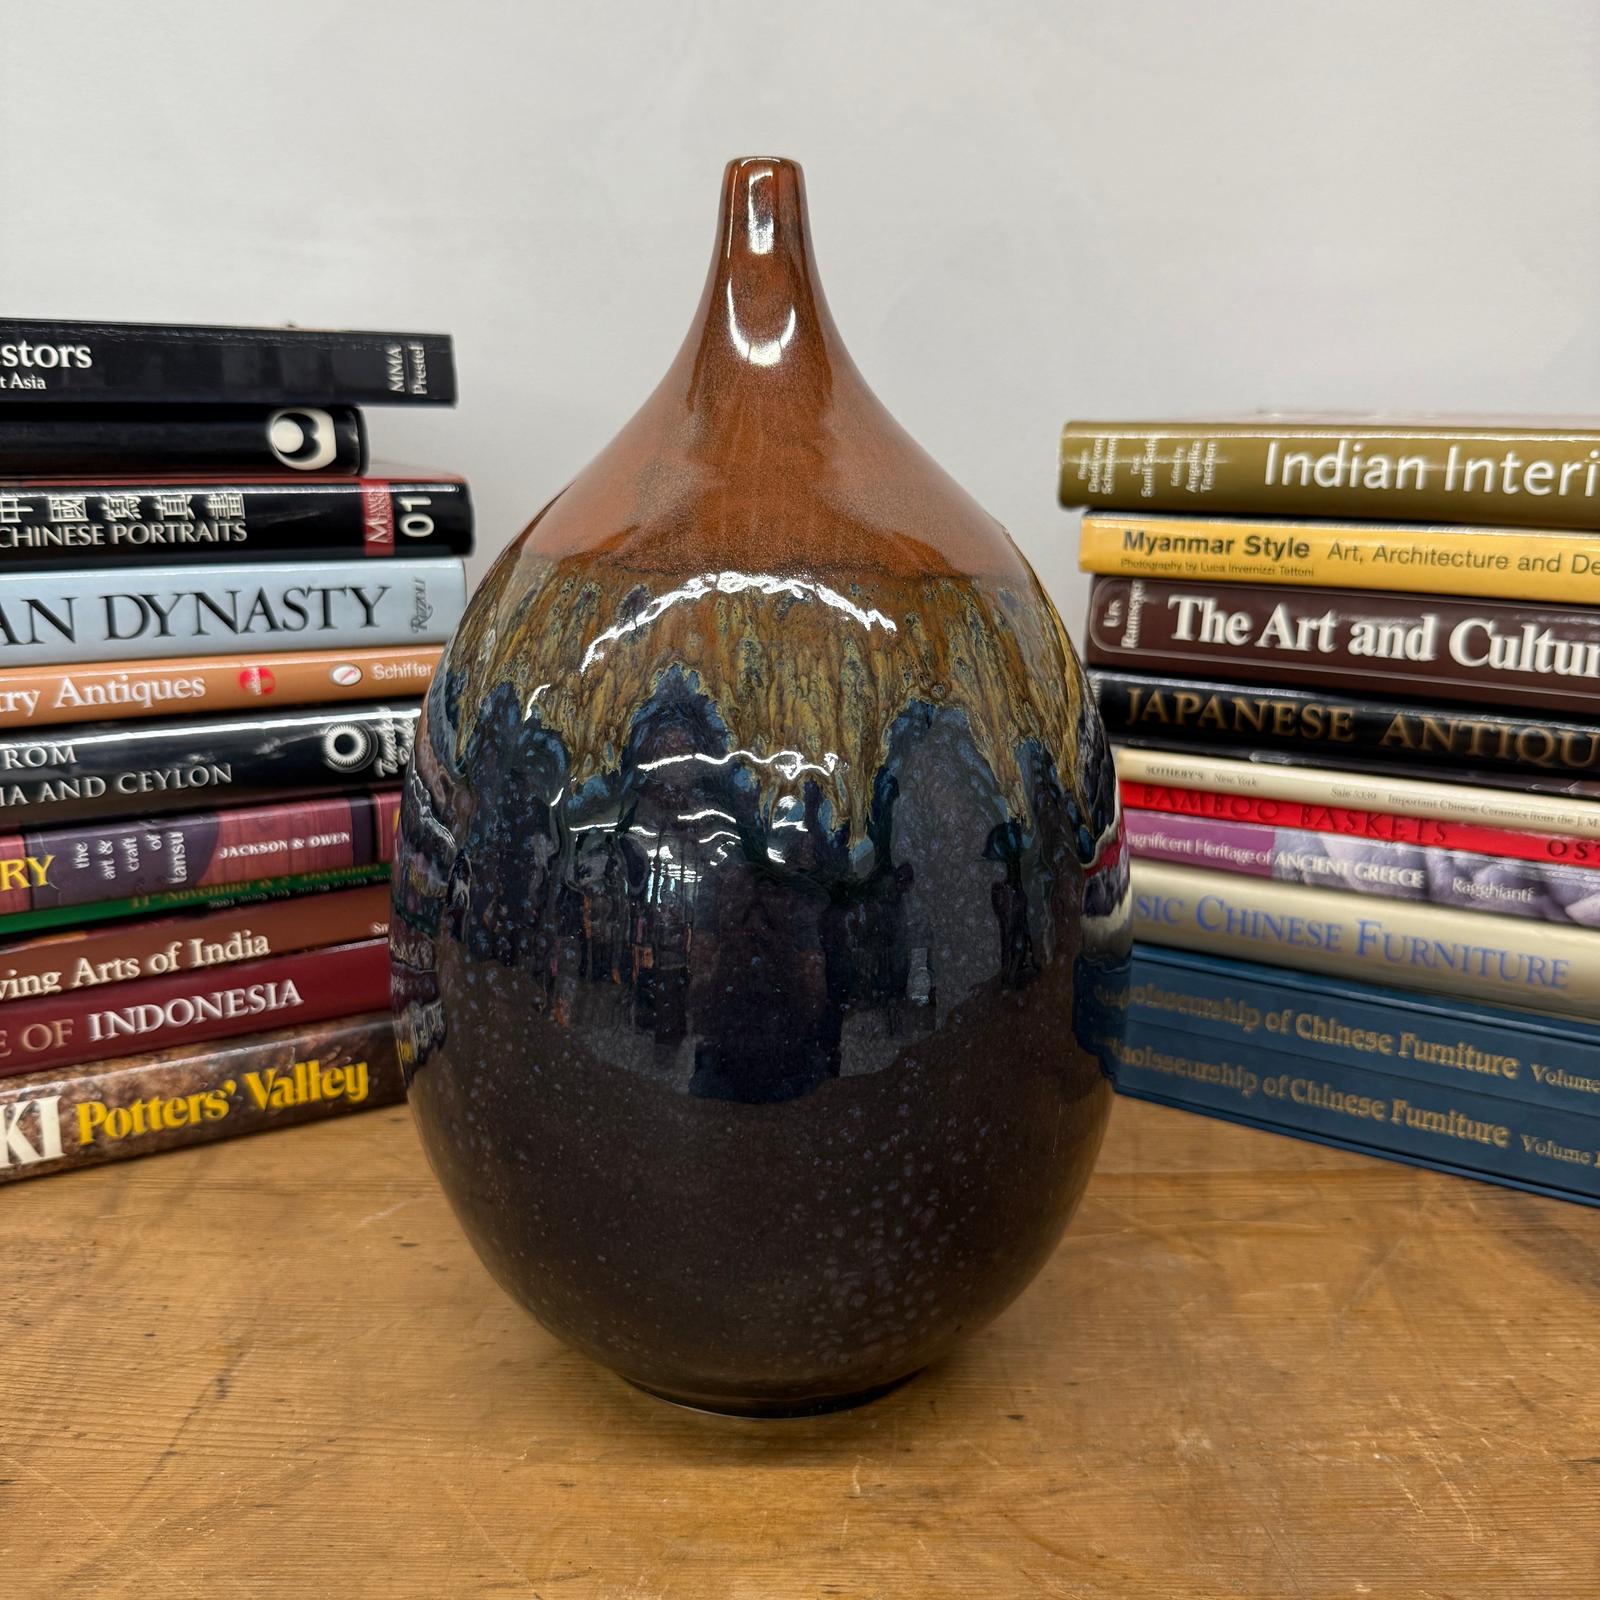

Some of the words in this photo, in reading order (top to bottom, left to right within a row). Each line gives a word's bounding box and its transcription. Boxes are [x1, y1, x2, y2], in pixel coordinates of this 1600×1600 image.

[0, 339, 93, 368] stors
[387, 343, 406, 392] MMA
[409, 341, 428, 395] Prestel
[10, 371, 47, 390] Asia
[1263, 439, 1427, 490] Indian
[1443, 443, 1600, 499] Interi
[0, 525, 106, 548] CHINESE
[108, 518, 248, 545] PORTRAITS
[398, 496, 435, 538] 01
[1120, 558, 1182, 572] Photography
[1185, 561, 1197, 573] by
[1200, 563, 1226, 573] Luca
[1229, 565, 1275, 577] Invernizzi
[1279, 565, 1314, 577] Tettoni
[1123, 531, 1235, 556] Myanmar
[1244, 535, 1310, 562] Style
[1326, 542, 1364, 564] Art,
[1373, 544, 1509, 571] Architecture
[1517, 553, 1562, 573] and
[1571, 554, 1600, 575] De
[101, 584, 391, 641] DYNASTY
[1103, 600, 1122, 628] Urs
[1167, 594, 1254, 647] The
[1254, 602, 1339, 654] Art
[1349, 613, 1438, 662] and
[53, 674, 207, 708] Antiques
[371, 660, 433, 680] Schiffer
[1126, 686, 1356, 743] JAPANESE
[1378, 712, 1600, 769] ANTIQU
[3, 744, 78, 770] ROM
[40, 775, 107, 804] AND
[115, 762, 232, 795] CEYLON
[1214, 773, 1234, 785] New
[1237, 774, 1257, 787] York
[1143, 786, 1281, 821] BAMBOO
[1300, 806, 1448, 844] BASKETS
[1546, 839, 1600, 861] OS
[1331, 786, 1350, 798] Sale
[1387, 794, 1437, 810] Important
[1440, 799, 1479, 814] Chinese
[1480, 805, 1528, 820] Ceramics
[1529, 811, 1554, 824] from
[1557, 814, 1574, 825] the
[72, 842, 91, 869] the
[98, 838, 113, 855] &
[145, 832, 162, 851] of
[167, 831, 188, 884] tansu
[217, 839, 288, 860] JACKSON
[291, 837, 305, 851] &
[307, 831, 350, 849] OWEN
[0, 855, 55, 892] RY
[100, 857, 116, 880] art
[1195, 839, 1254, 866] Heritage
[1255, 849, 1273, 867] of
[1274, 852, 1351, 878] ANCIENT
[1353, 861, 1425, 889] GREECE
[70, 953, 142, 989] Arts
[149, 945, 183, 973] of
[188, 929, 272, 968] India
[1195, 894, 1343, 953] CHINESE
[1356, 918, 1572, 991] FURNITURE
[22, 1018, 74, 1051] OF
[87, 979, 304, 1042] INDONESIA
[1264, 1008, 1293, 1035] of
[1294, 1012, 1395, 1056] Chinese
[1398, 1031, 1520, 1080] Furniture
[1529, 1062, 1600, 1095] Volume
[0, 1095, 67, 1169] KI
[76, 1079, 237, 1146] Potters'
[244, 1058, 370, 1113] Valley
[1261, 1074, 1290, 1099] of
[1290, 1077, 1387, 1122] Chinese
[1390, 1097, 1512, 1149] Furniture
[1519, 1132, 1592, 1167] Volume
